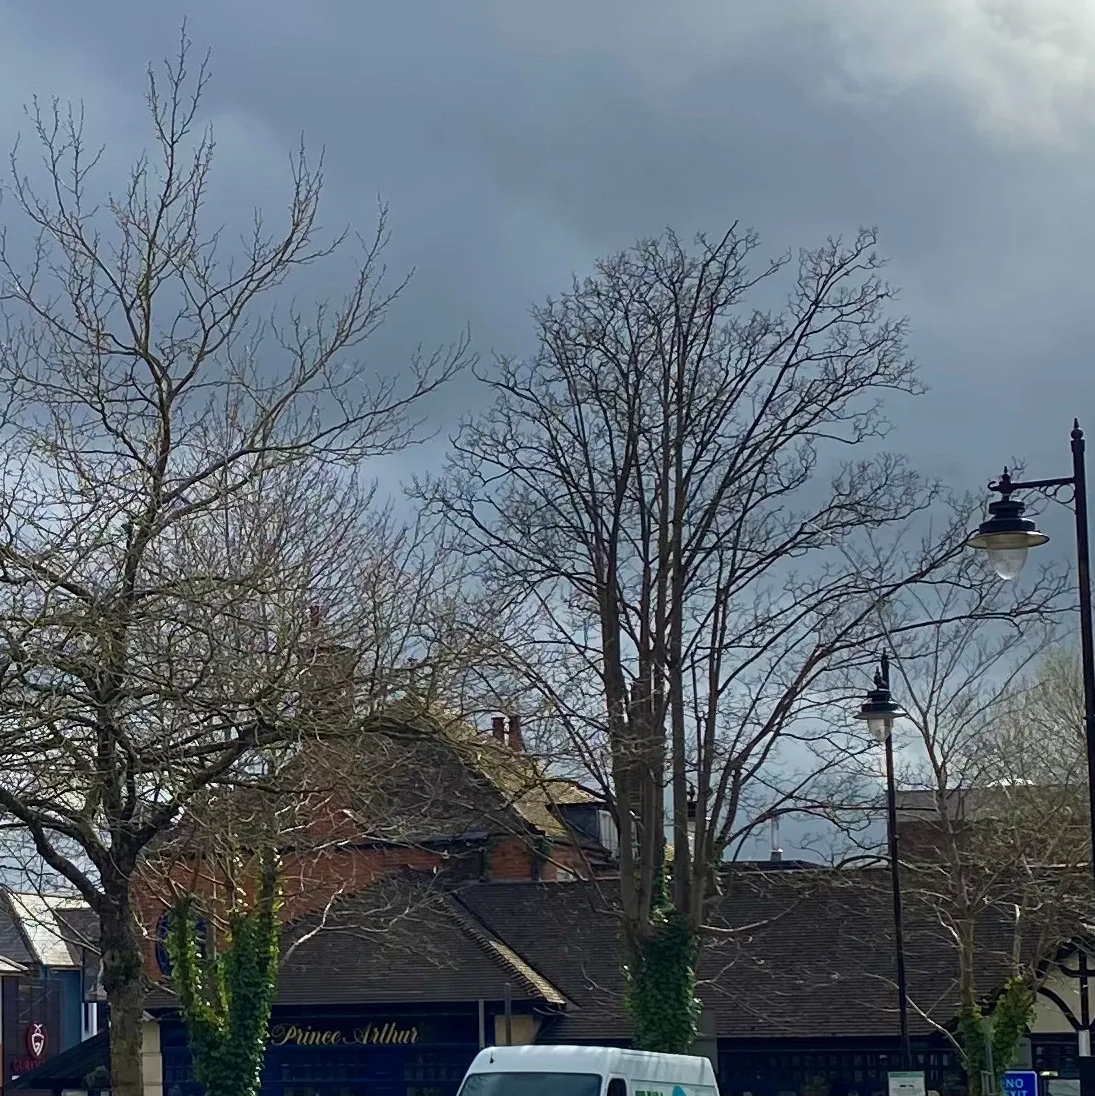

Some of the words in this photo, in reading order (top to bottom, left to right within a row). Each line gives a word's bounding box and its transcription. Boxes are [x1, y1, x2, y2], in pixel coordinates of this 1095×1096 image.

[271, 1023, 341, 1046] Prince
[342, 1022, 420, 1045] Arthur
[1006, 1079, 1024, 1089] NO
